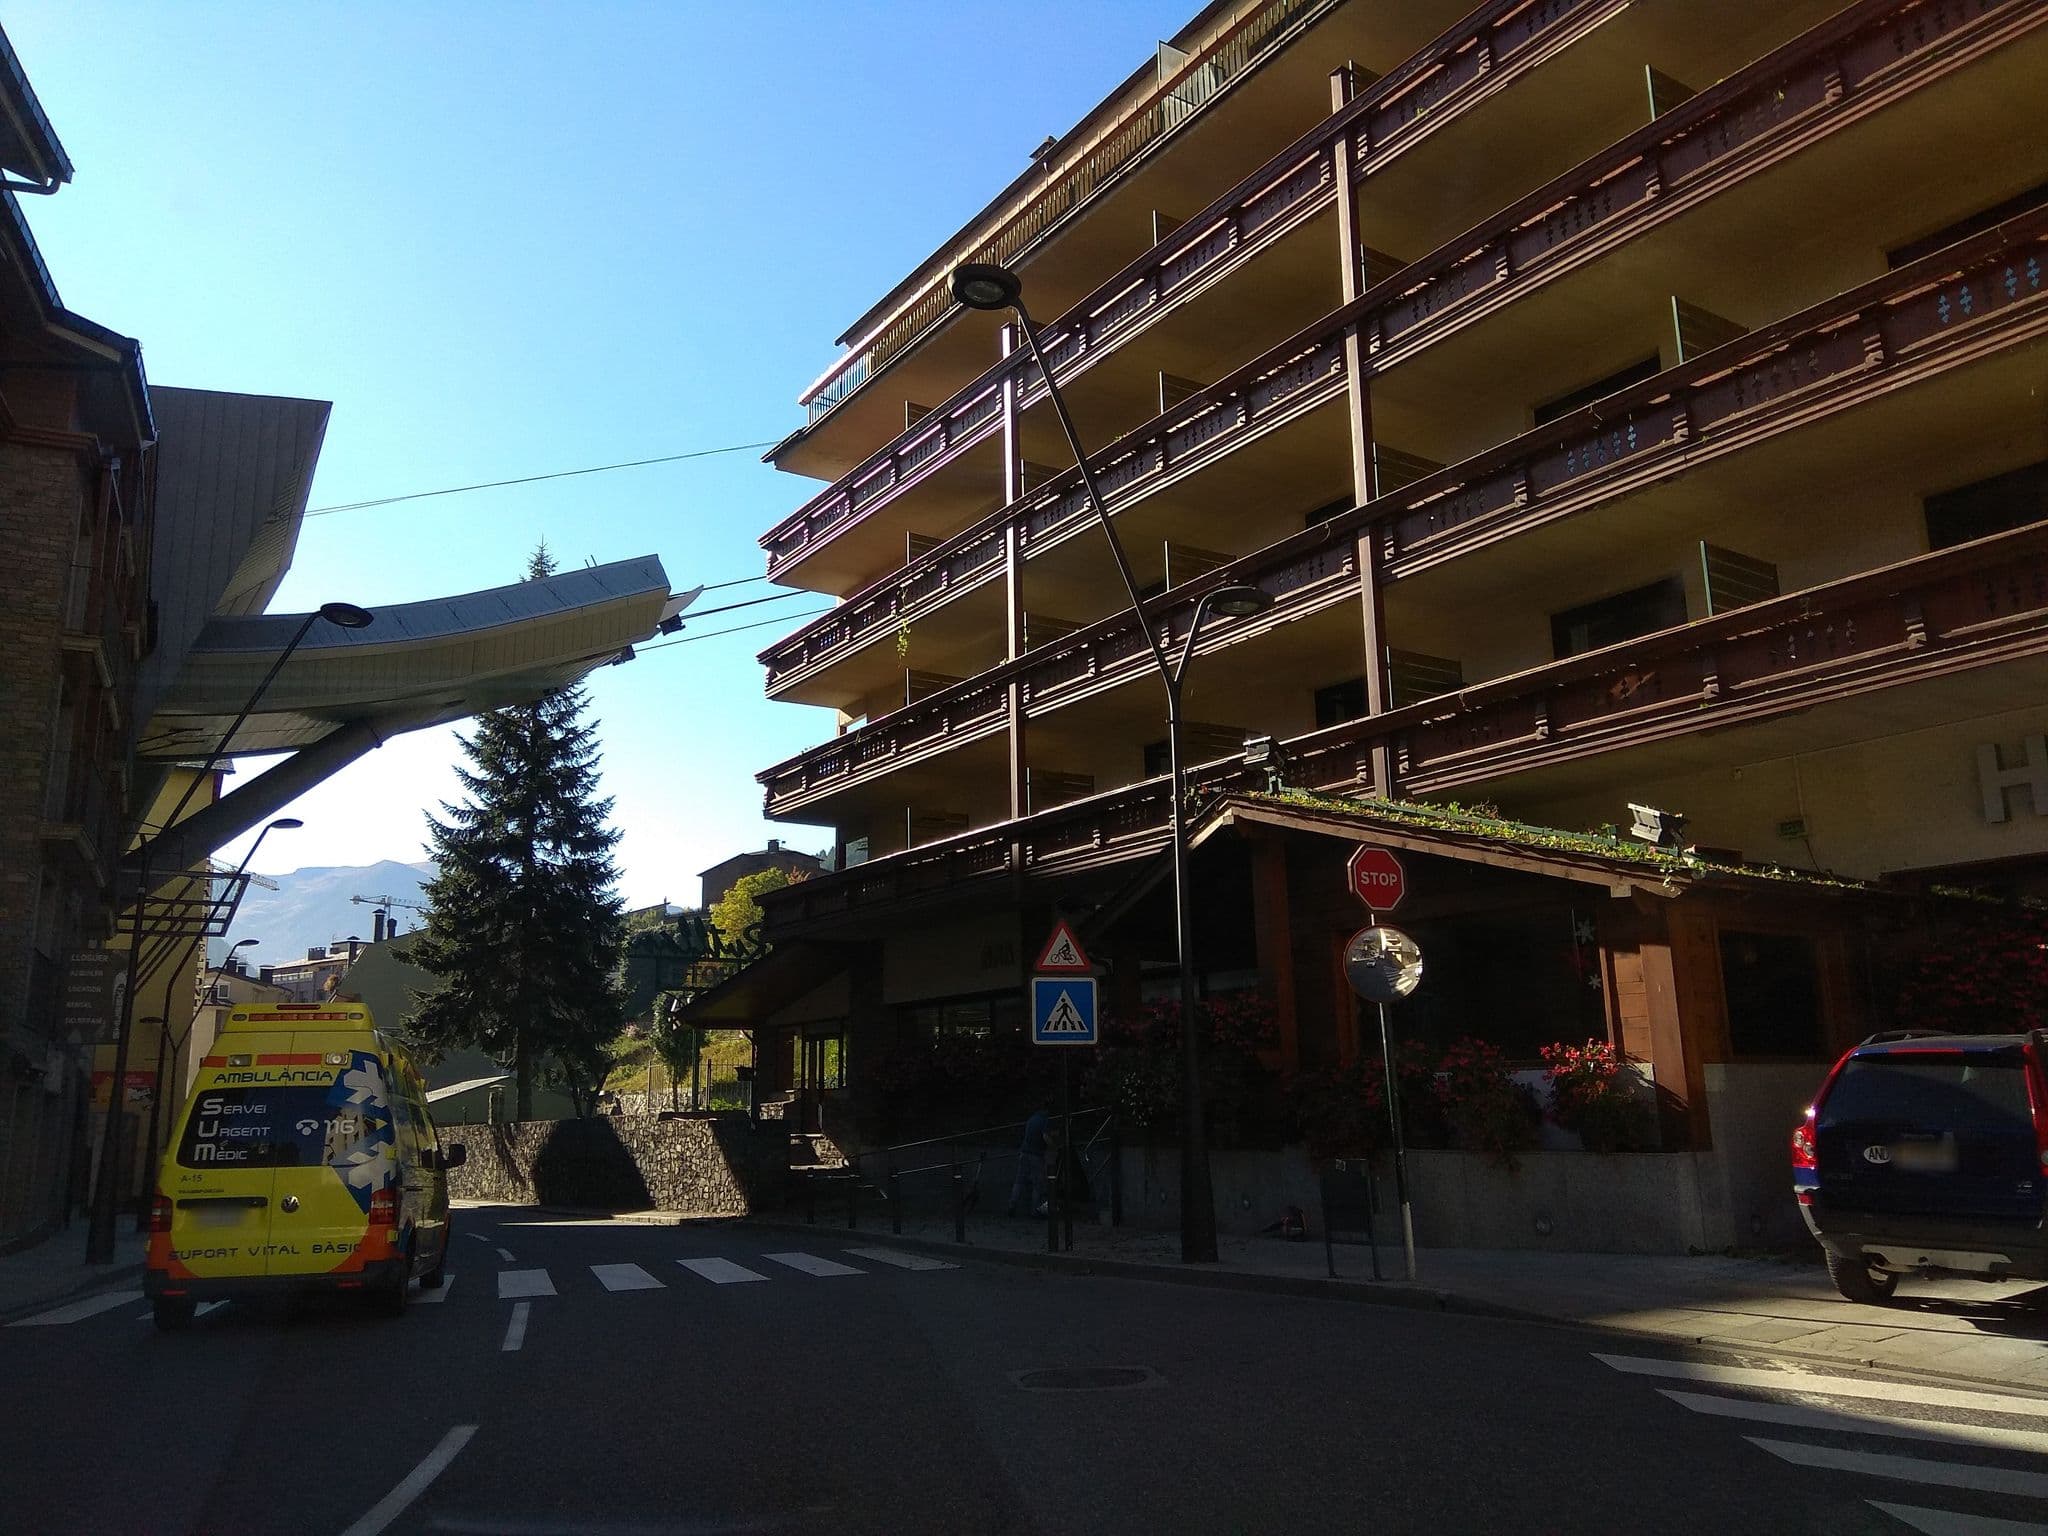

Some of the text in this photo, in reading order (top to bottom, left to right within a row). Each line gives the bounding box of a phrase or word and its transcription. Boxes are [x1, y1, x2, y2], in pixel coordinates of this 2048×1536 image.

[1361, 871, 1398, 886] STOP
[214, 1067, 333, 1084] AMBULÀNCIA
[200, 1098, 267, 1116] SERVEI
[198, 1120, 272, 1138] URGENT
[324, 1119, 356, 1135] 116
[193, 1143, 249, 1161] MÈDIC
[181, 1173, 203, 1183] A-15
[168, 1247, 239, 1261] SUPORT
[247, 1244, 300, 1257] VITAL
